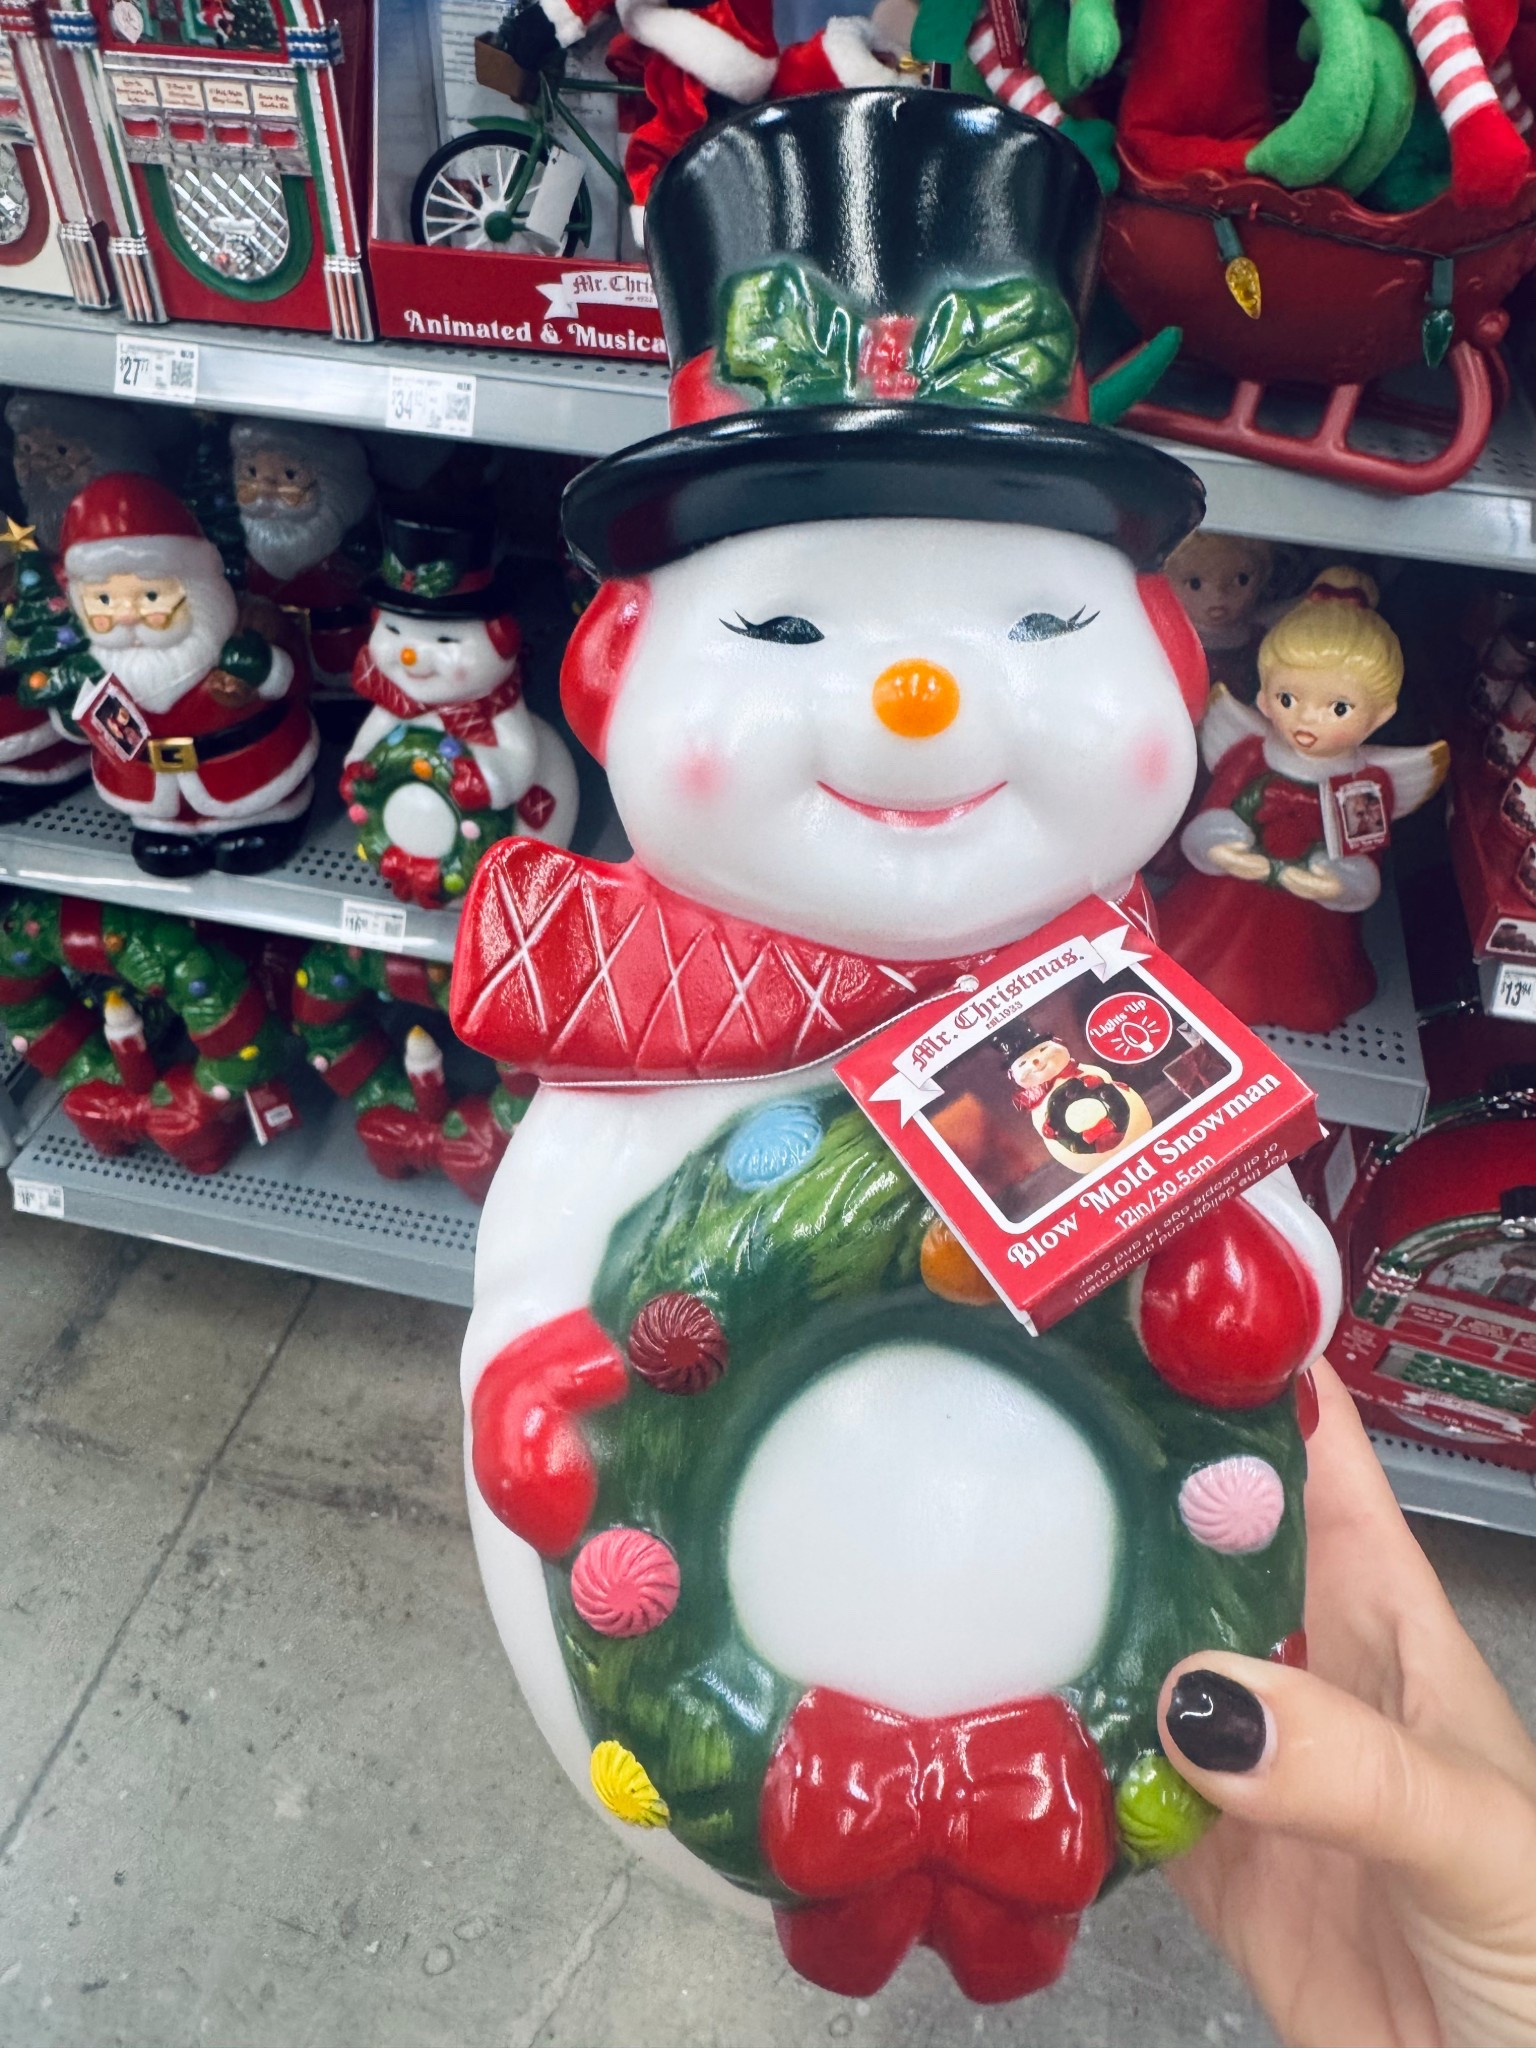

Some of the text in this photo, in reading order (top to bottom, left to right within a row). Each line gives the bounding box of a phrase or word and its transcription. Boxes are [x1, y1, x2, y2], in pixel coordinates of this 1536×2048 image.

[573, 275, 607, 294] Mr.
[404, 309, 667, 353] Animated & Musica
[1089, 999, 1147, 1038] Lights Up
[911, 1032, 958, 1072] Mr.
[1263, 1142, 1278, 1159] of
[1007, 1073, 1281, 1268] Blow Mold Snowman
[1243, 1155, 1260, 1173] all
[1193, 1167, 1239, 1206] people
[1238, 1168, 1261, 1187] the
[1163, 1205, 1190, 1228] age
[1189, 1186, 1235, 1223] delight
[1158, 1222, 1185, 1245] and
[1114, 1240, 1141, 1265] and
